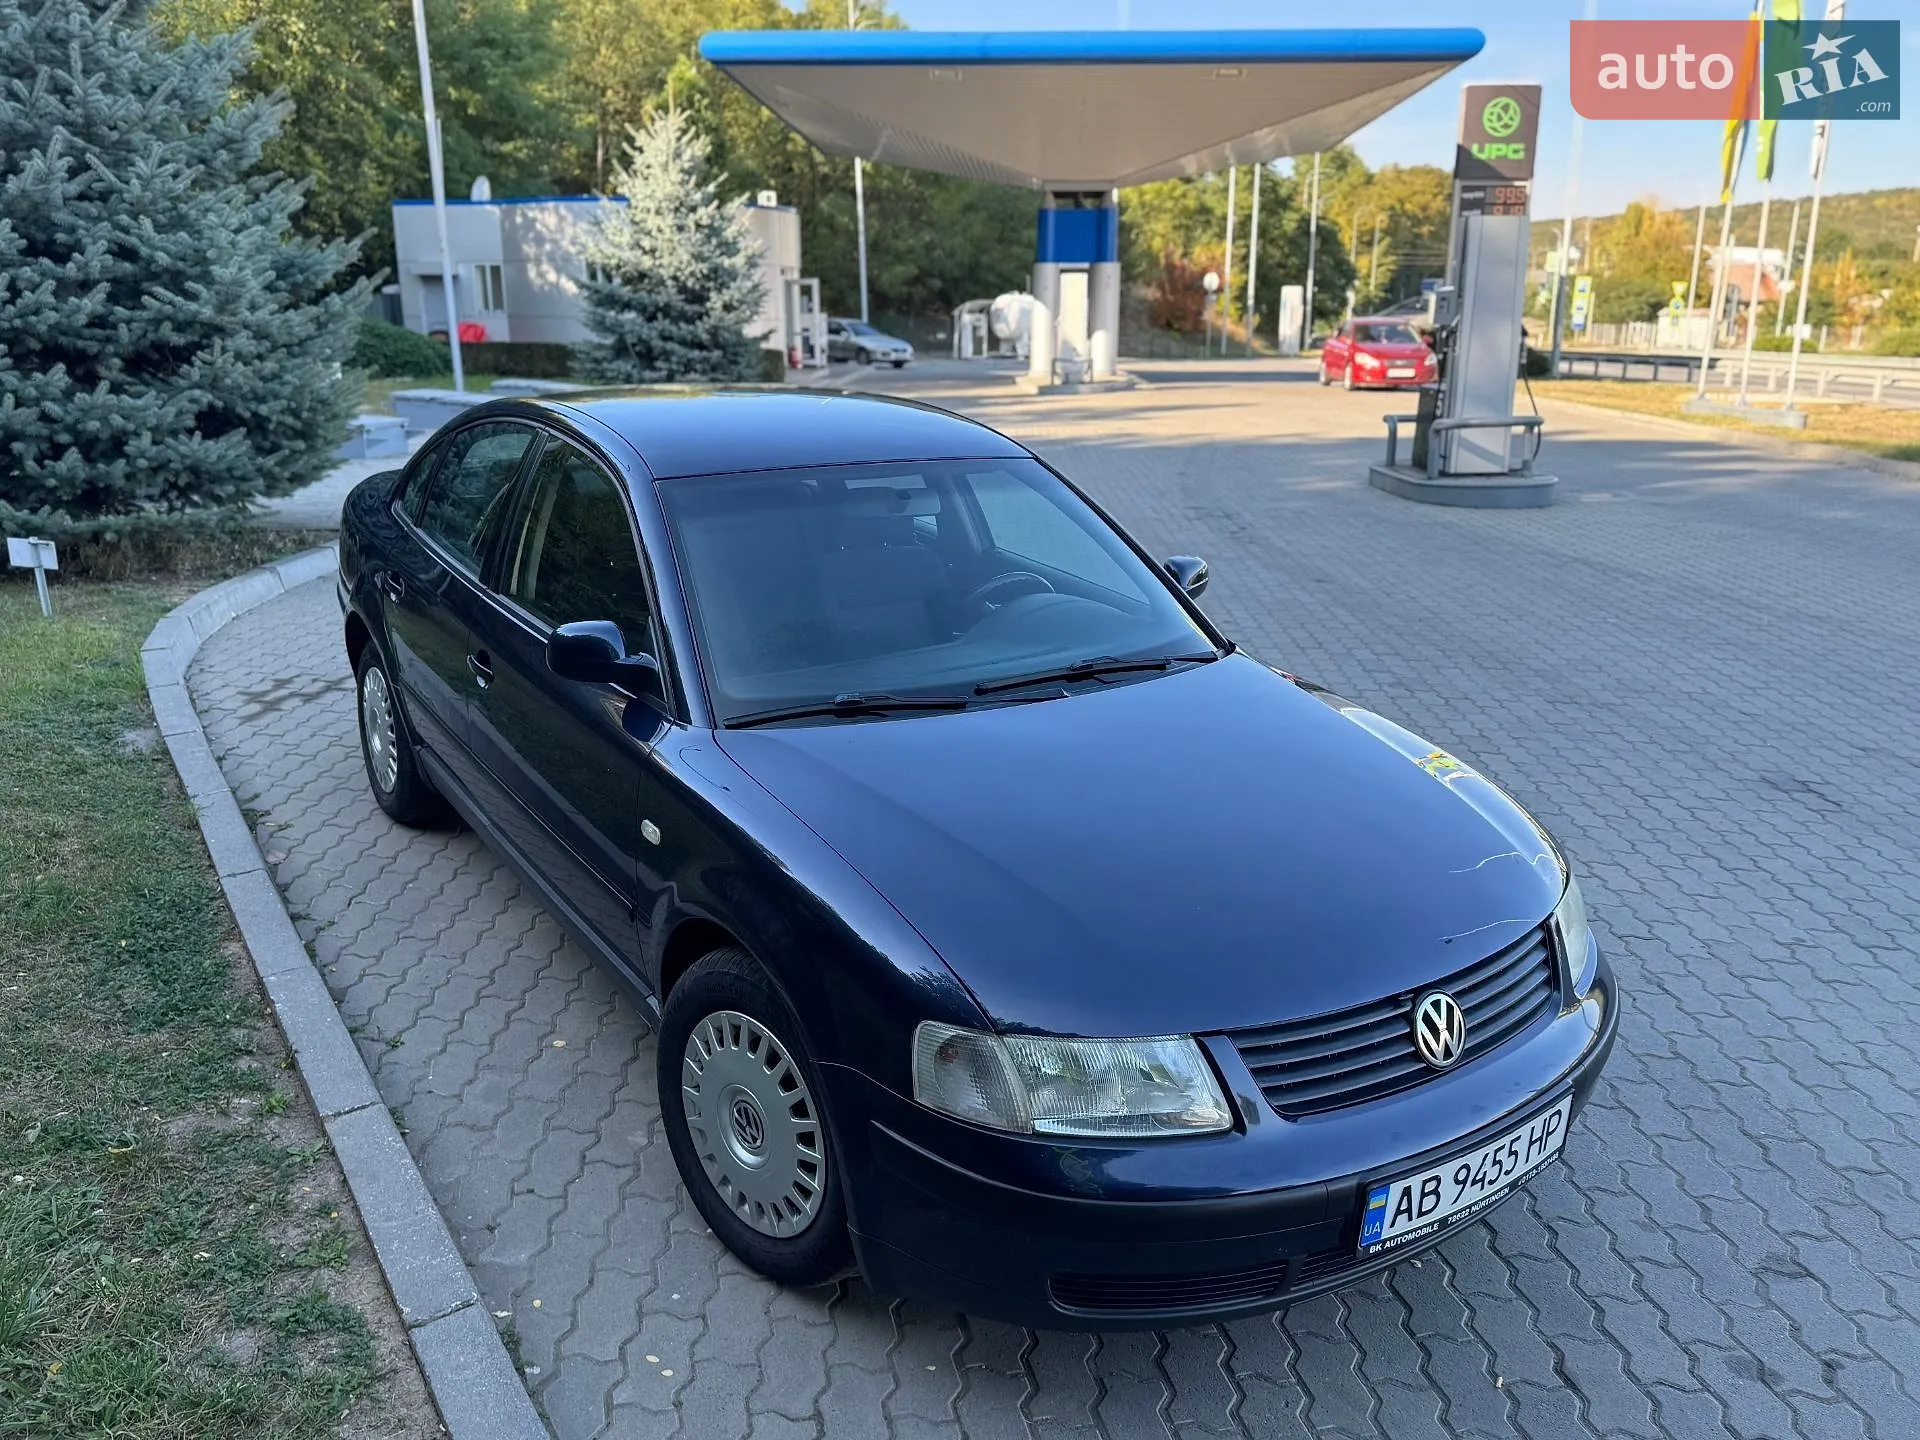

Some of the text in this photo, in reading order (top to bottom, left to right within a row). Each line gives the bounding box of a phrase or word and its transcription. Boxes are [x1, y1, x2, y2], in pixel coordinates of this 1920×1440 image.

[1471, 142, 1525, 160] UPG
[1389, 1108, 1562, 1229] AB 9455 HP
[1364, 1221, 1381, 1237] UA
[1369, 1242, 1383, 1254] BK
[1384, 1222, 1440, 1249] AUTOMOBILE
